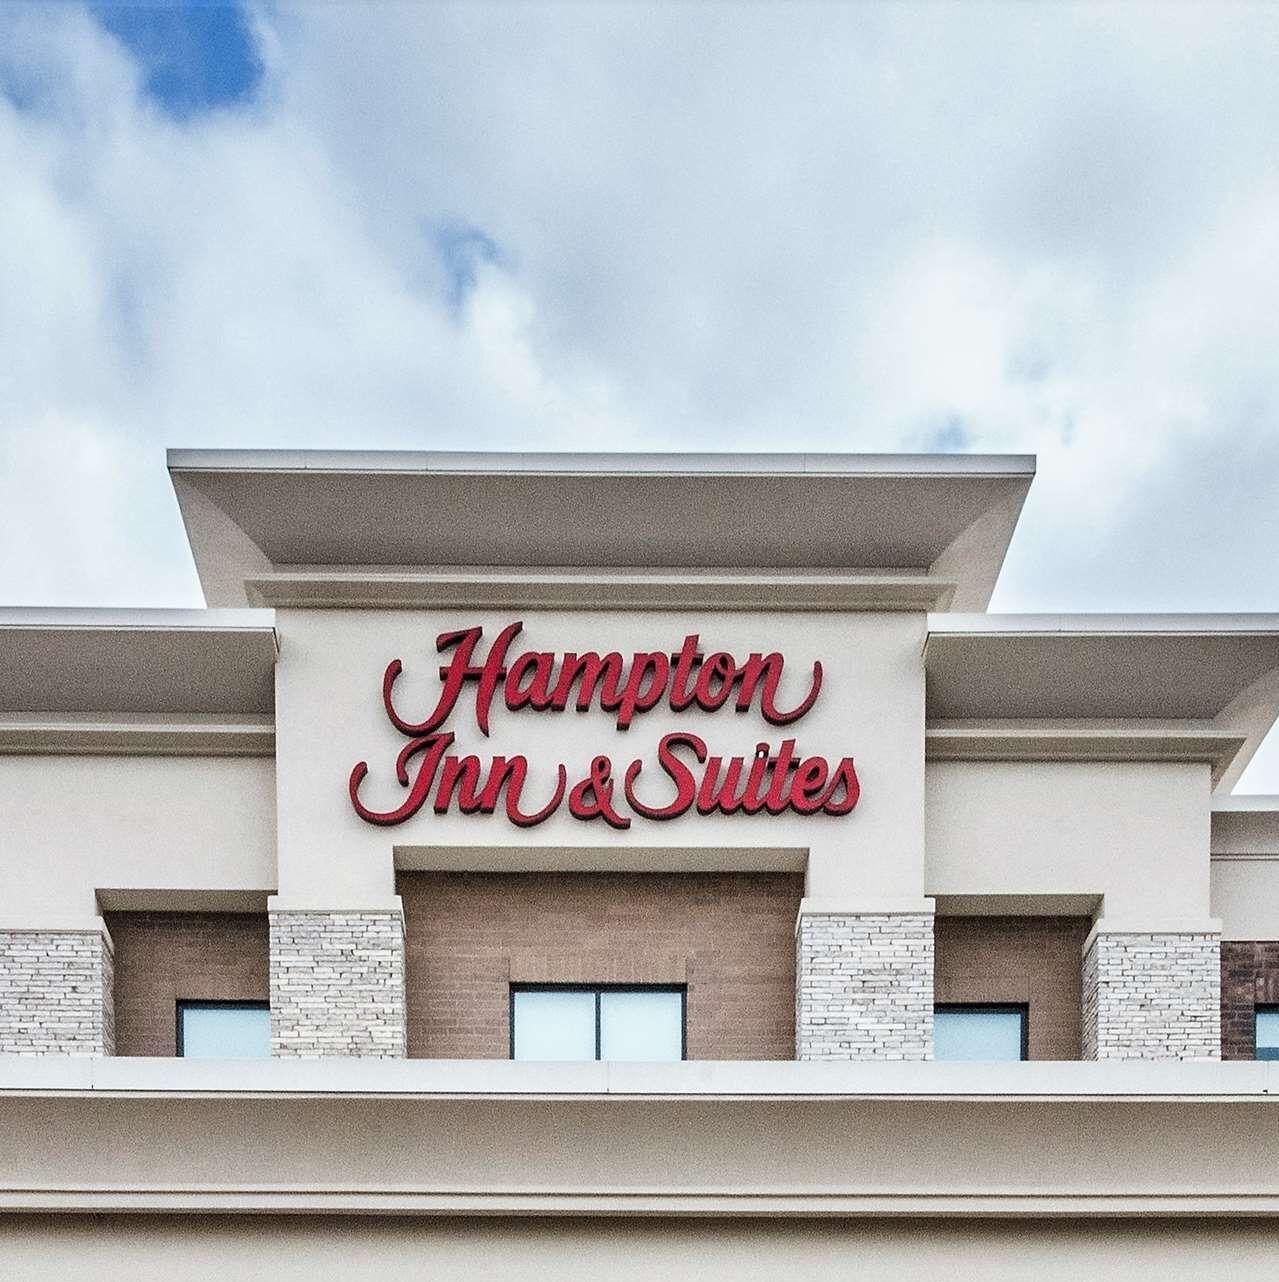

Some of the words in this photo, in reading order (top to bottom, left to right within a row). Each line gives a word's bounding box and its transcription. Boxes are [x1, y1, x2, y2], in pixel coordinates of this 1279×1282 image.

[383, 621, 823, 737] Hampton
[349, 731, 567, 827] Inn
[568, 755, 631, 829] &
[625, 732, 861, 821] Suites
